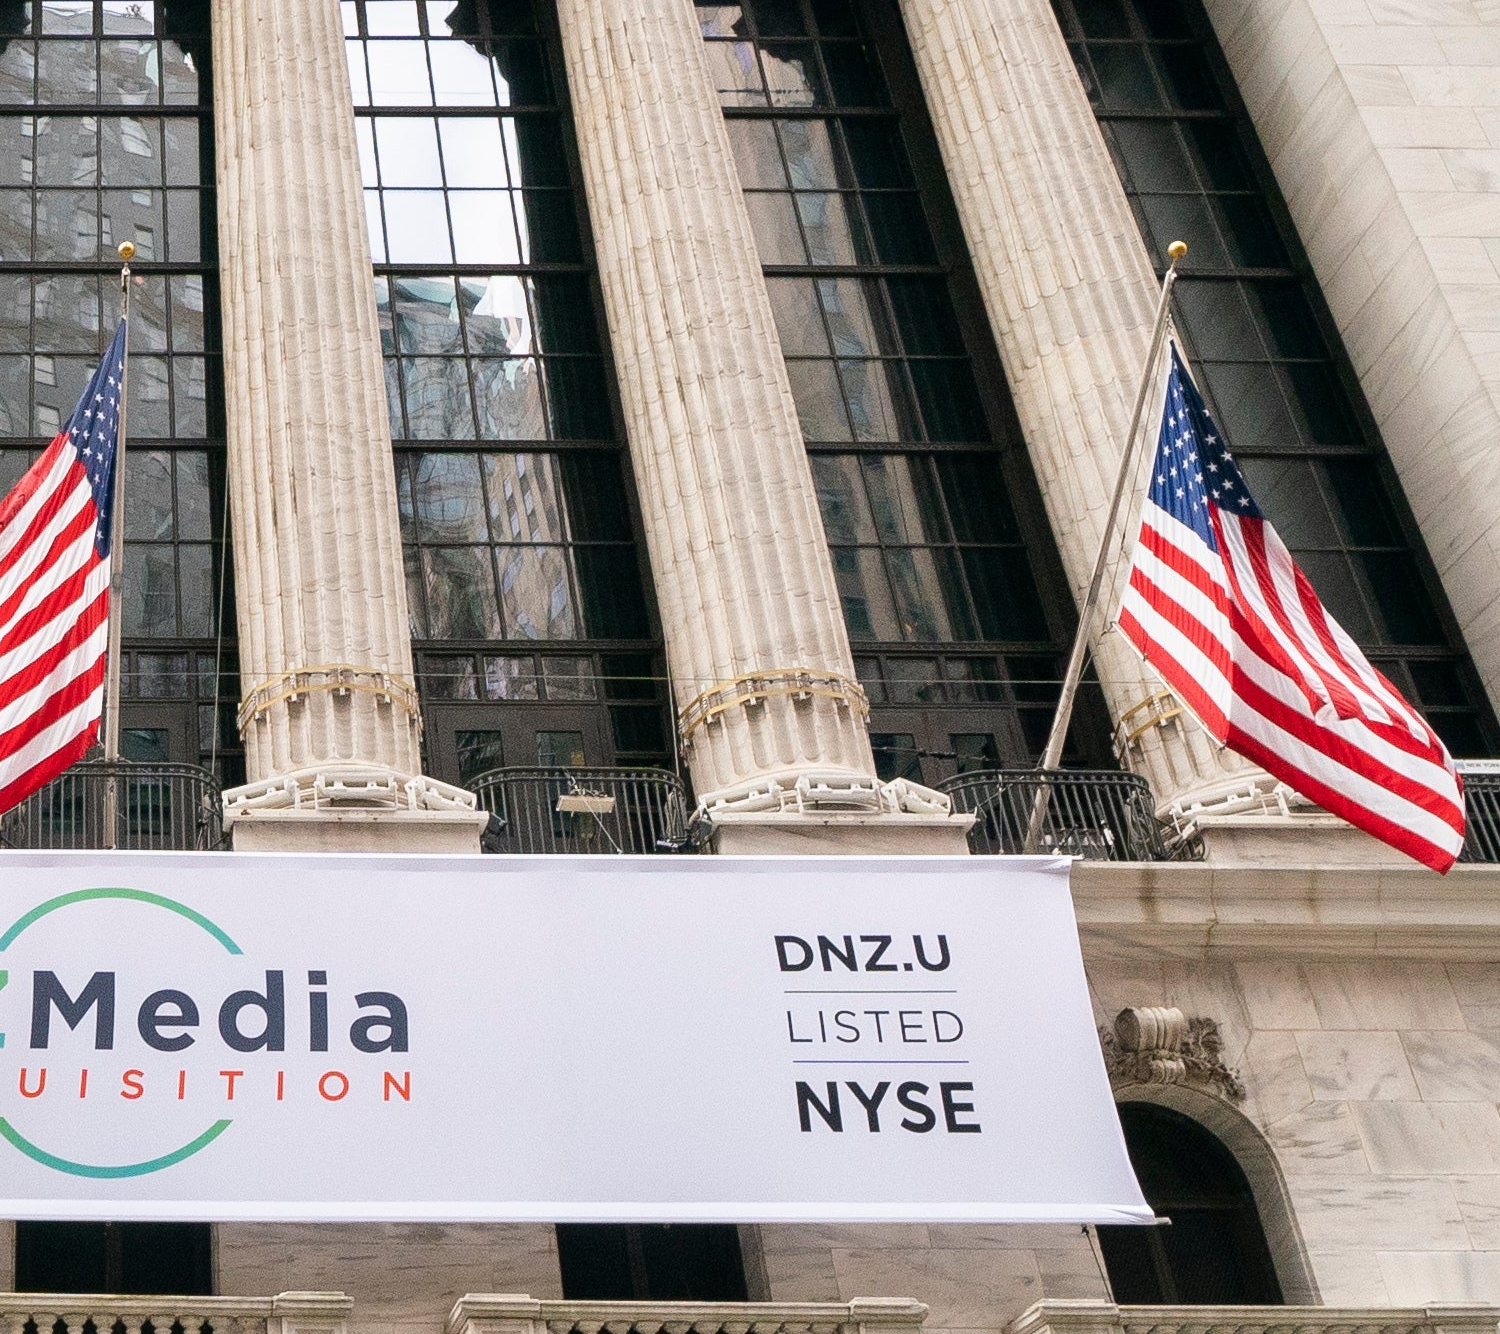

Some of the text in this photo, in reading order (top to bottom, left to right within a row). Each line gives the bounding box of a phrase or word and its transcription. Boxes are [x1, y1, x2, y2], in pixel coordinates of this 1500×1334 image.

[774, 934, 951, 972] DNZ.U
[786, 1010, 964, 1043] LISTED
[795, 1081, 982, 1134] NYSE
